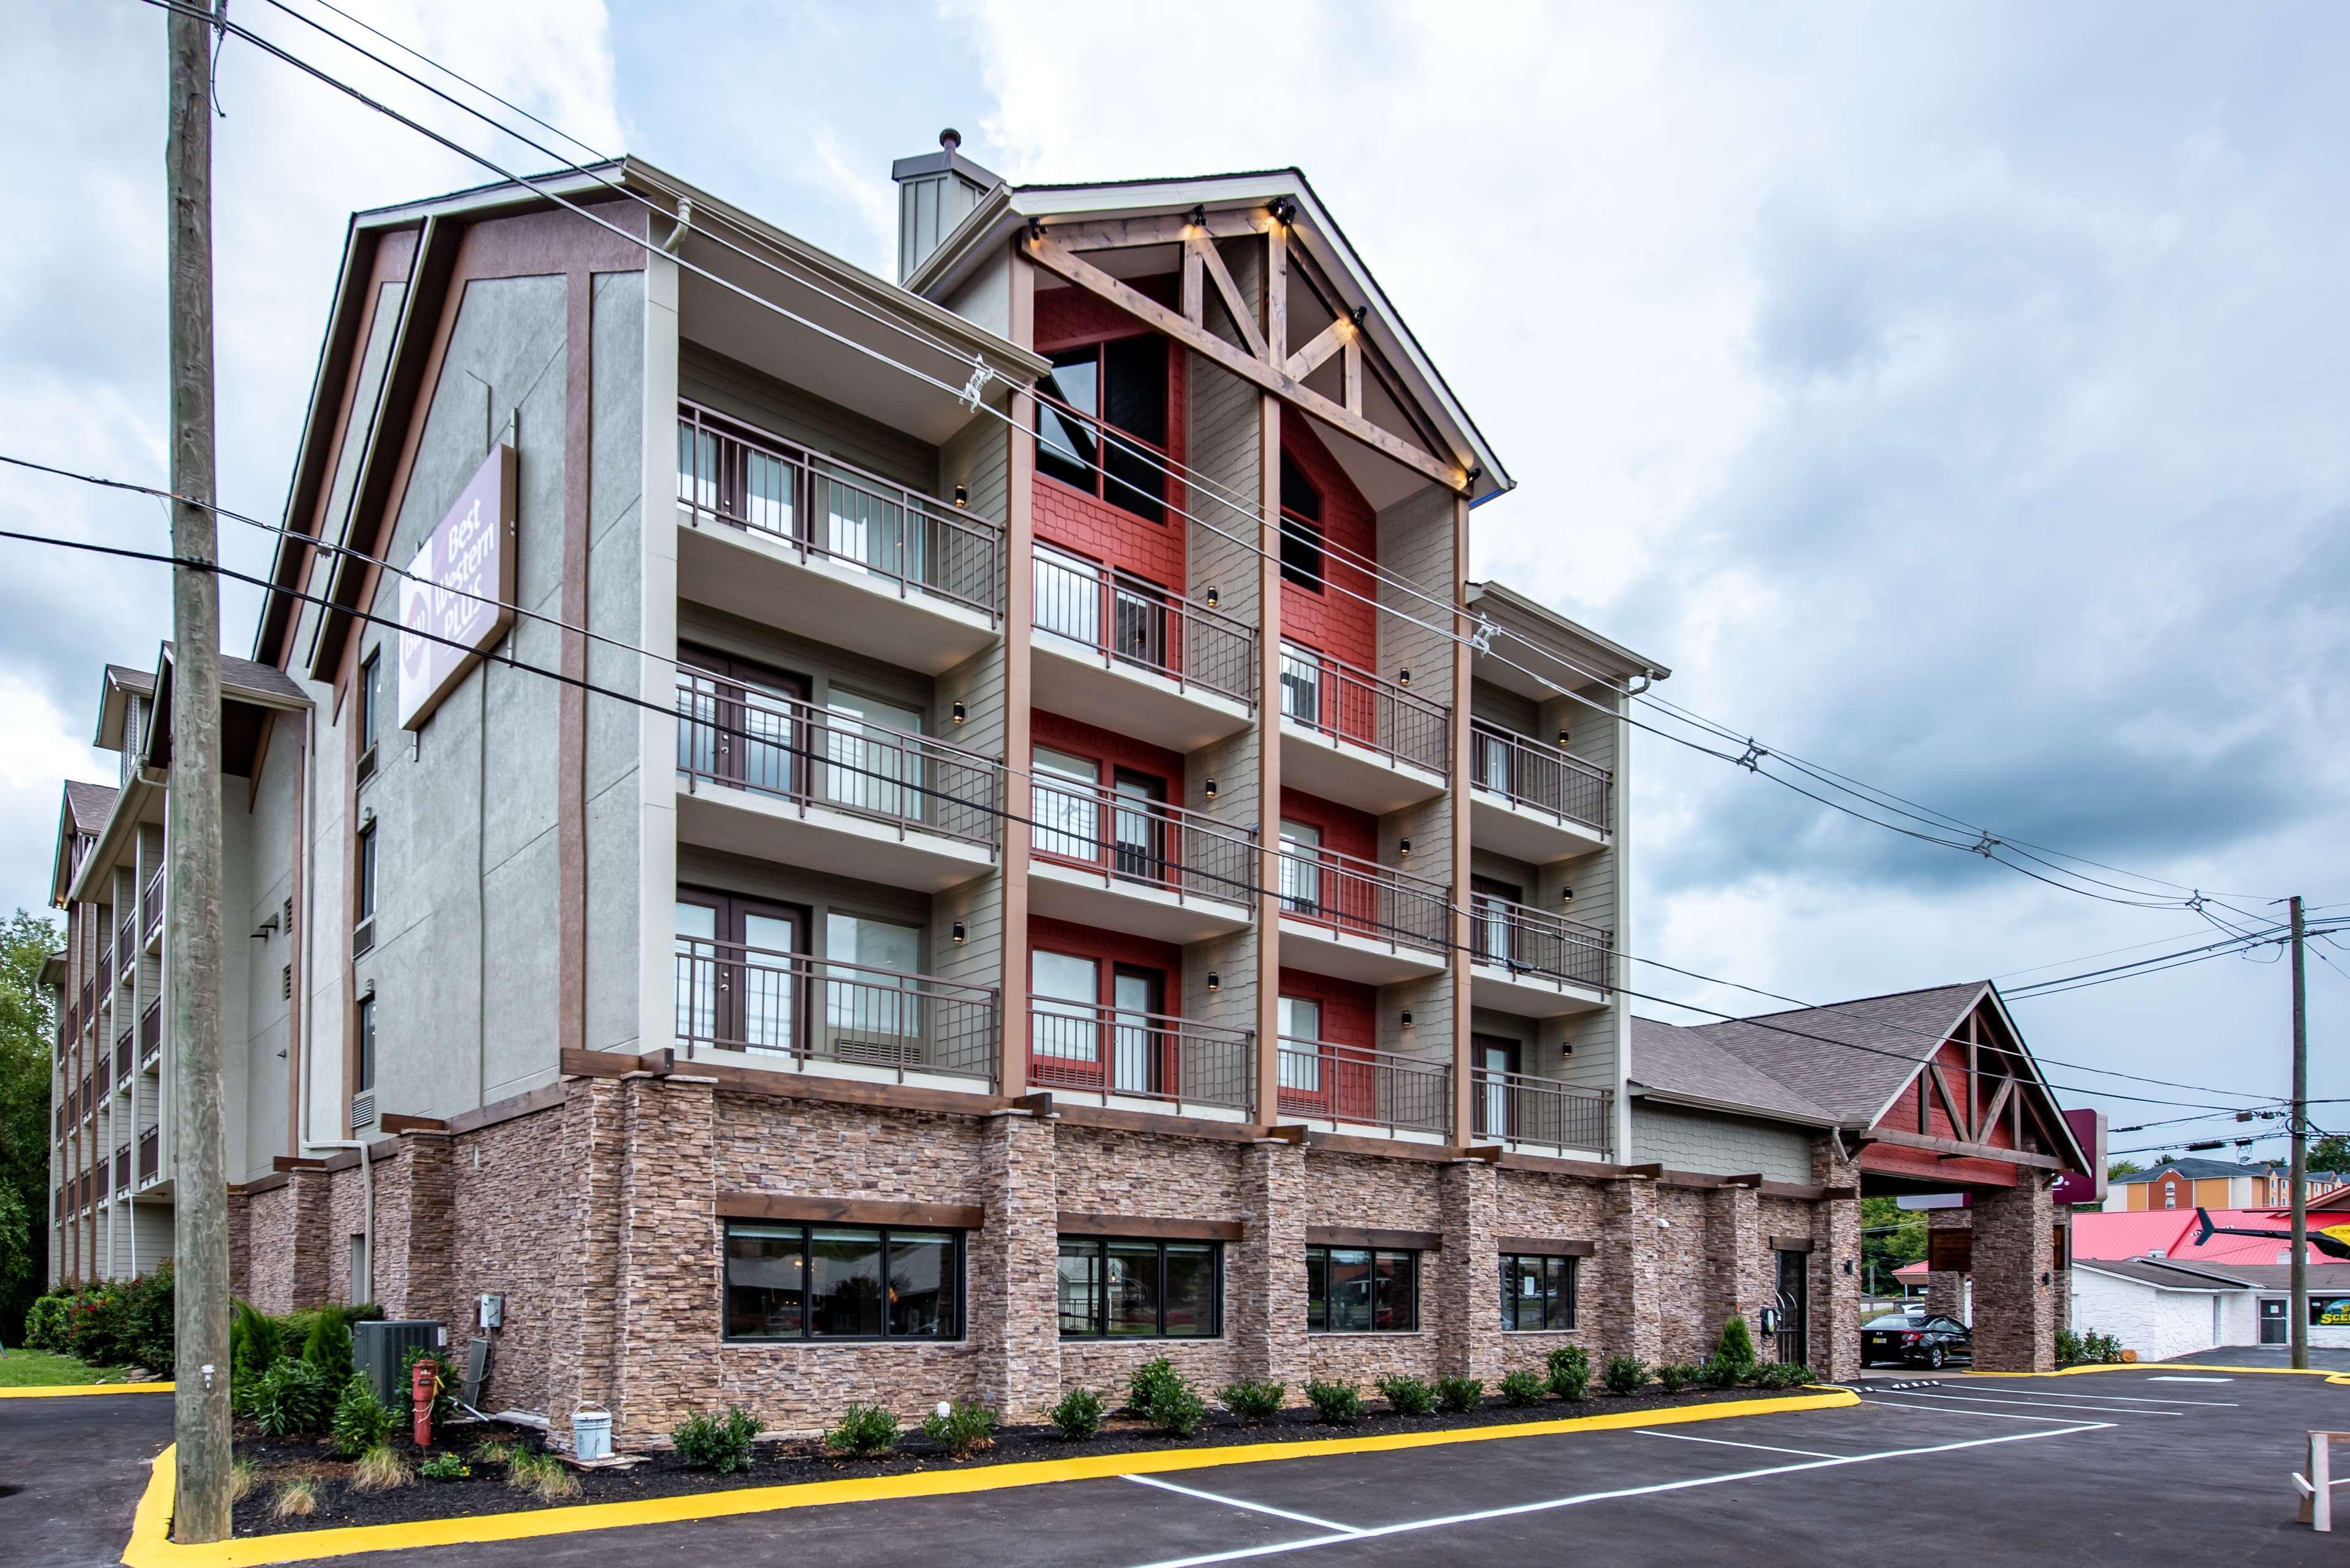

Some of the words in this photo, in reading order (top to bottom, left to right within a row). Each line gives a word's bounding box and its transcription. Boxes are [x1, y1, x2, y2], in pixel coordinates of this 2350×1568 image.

[448, 498, 481, 564] Best
[435, 522, 495, 617] Western
[444, 573, 482, 640] PLUS
[2321, 1313, 2350, 1324] SCE
